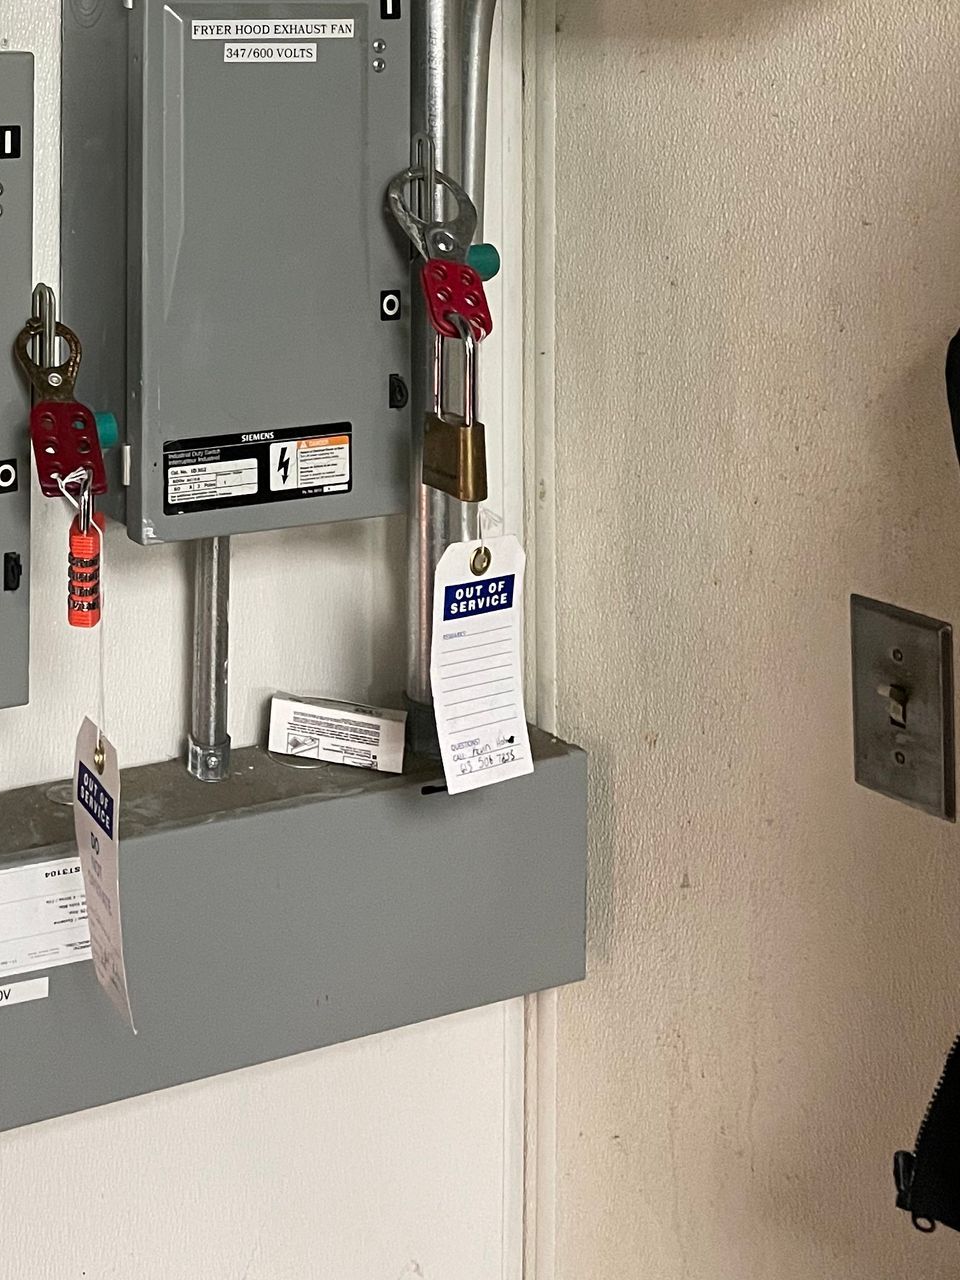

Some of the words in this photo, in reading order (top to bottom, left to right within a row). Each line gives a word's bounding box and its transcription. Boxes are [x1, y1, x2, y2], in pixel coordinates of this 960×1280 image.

[193, 24, 232, 36] FRYER
[235, 24, 270, 35] HOOD
[274, 24, 328, 34] EXHAUST
[331, 24, 353, 34] FAN
[226, 48, 274, 58] 347/600
[276, 48, 314, 58] VOLTS
[241, 432, 274, 442] SIEMENS
[455, 584, 483, 600] OUT
[488, 580, 506, 594] OF
[450, 592, 508, 614] SERVICE
[83, 773, 98, 795] OUT
[99, 791, 109, 808] OF
[80, 786, 110, 830] SERVICE
